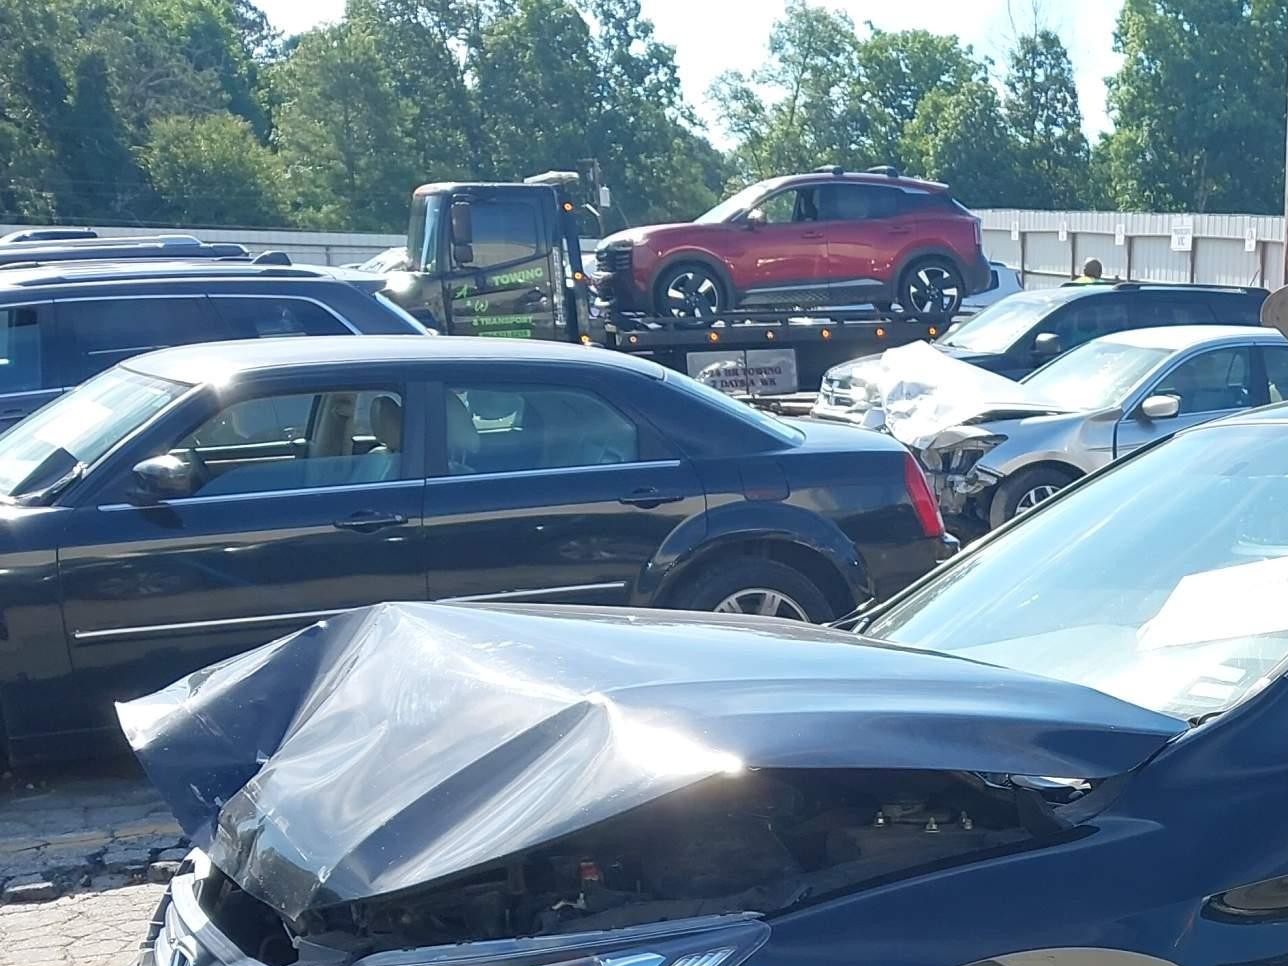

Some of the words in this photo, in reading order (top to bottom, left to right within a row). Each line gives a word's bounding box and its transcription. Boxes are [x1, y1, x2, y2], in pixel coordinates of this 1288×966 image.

[492, 268, 543, 286] TOWING
[480, 316, 533, 326] TRANSPORT
[742, 367, 782, 376] TOWING
